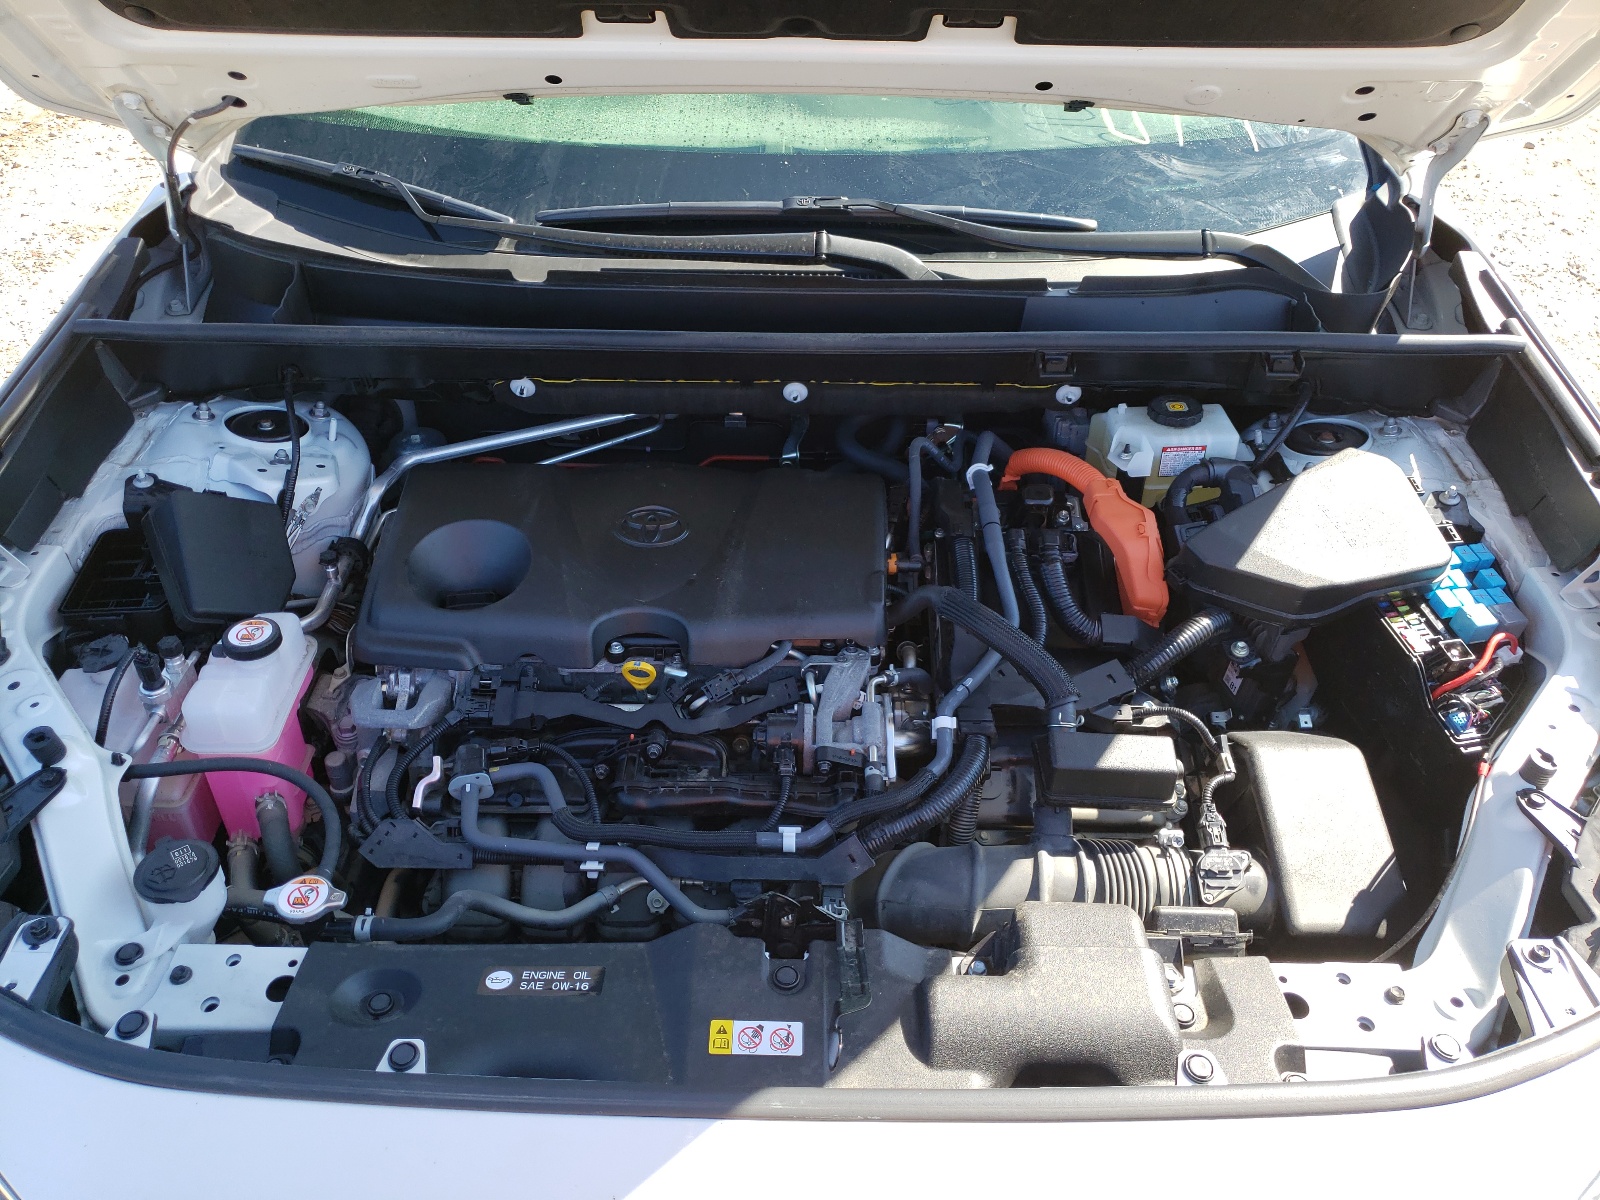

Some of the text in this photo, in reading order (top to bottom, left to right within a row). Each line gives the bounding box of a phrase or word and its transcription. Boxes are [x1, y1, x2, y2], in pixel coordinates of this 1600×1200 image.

[522, 971, 591, 979] ENGINE OIL
[520, 981, 589, 990] SAE 0W-16
